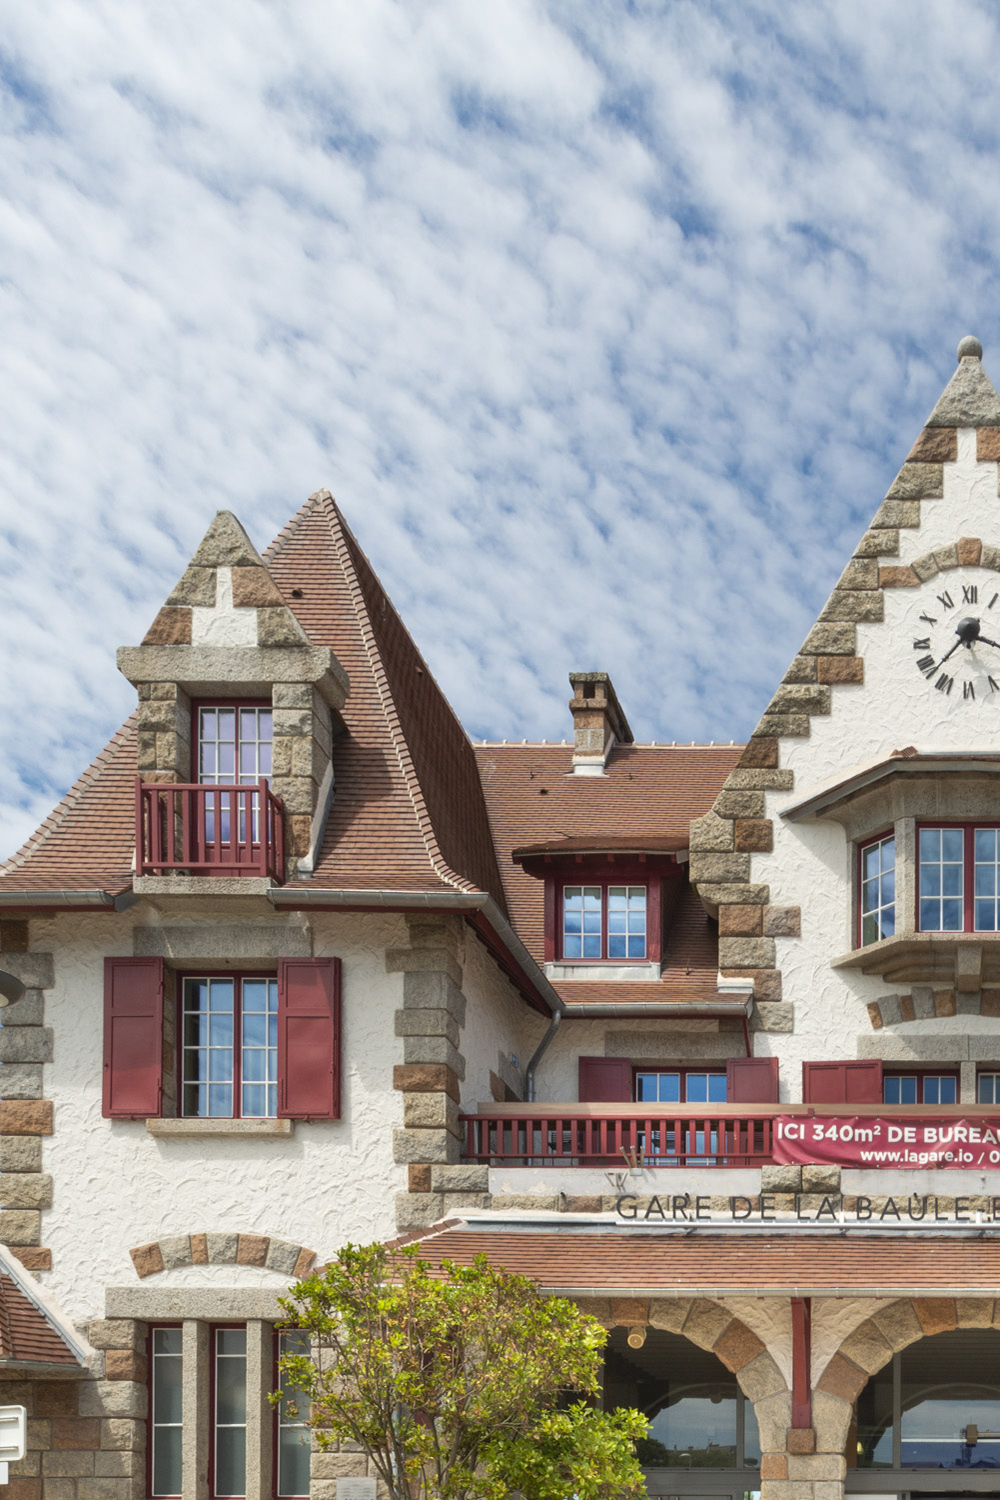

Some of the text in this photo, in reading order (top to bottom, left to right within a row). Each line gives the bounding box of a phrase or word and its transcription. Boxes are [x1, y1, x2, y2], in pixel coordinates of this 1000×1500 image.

[962, 585, 978, 604] XII
[777, 1123, 805, 1140] ICI
[888, 1127, 917, 1143] DE
[860, 1149, 974, 1164] www.lagare.io
[616, 1195, 711, 1220] GARE
[732, 1196, 776, 1220] DE
[797, 1196, 837, 1220] LA
